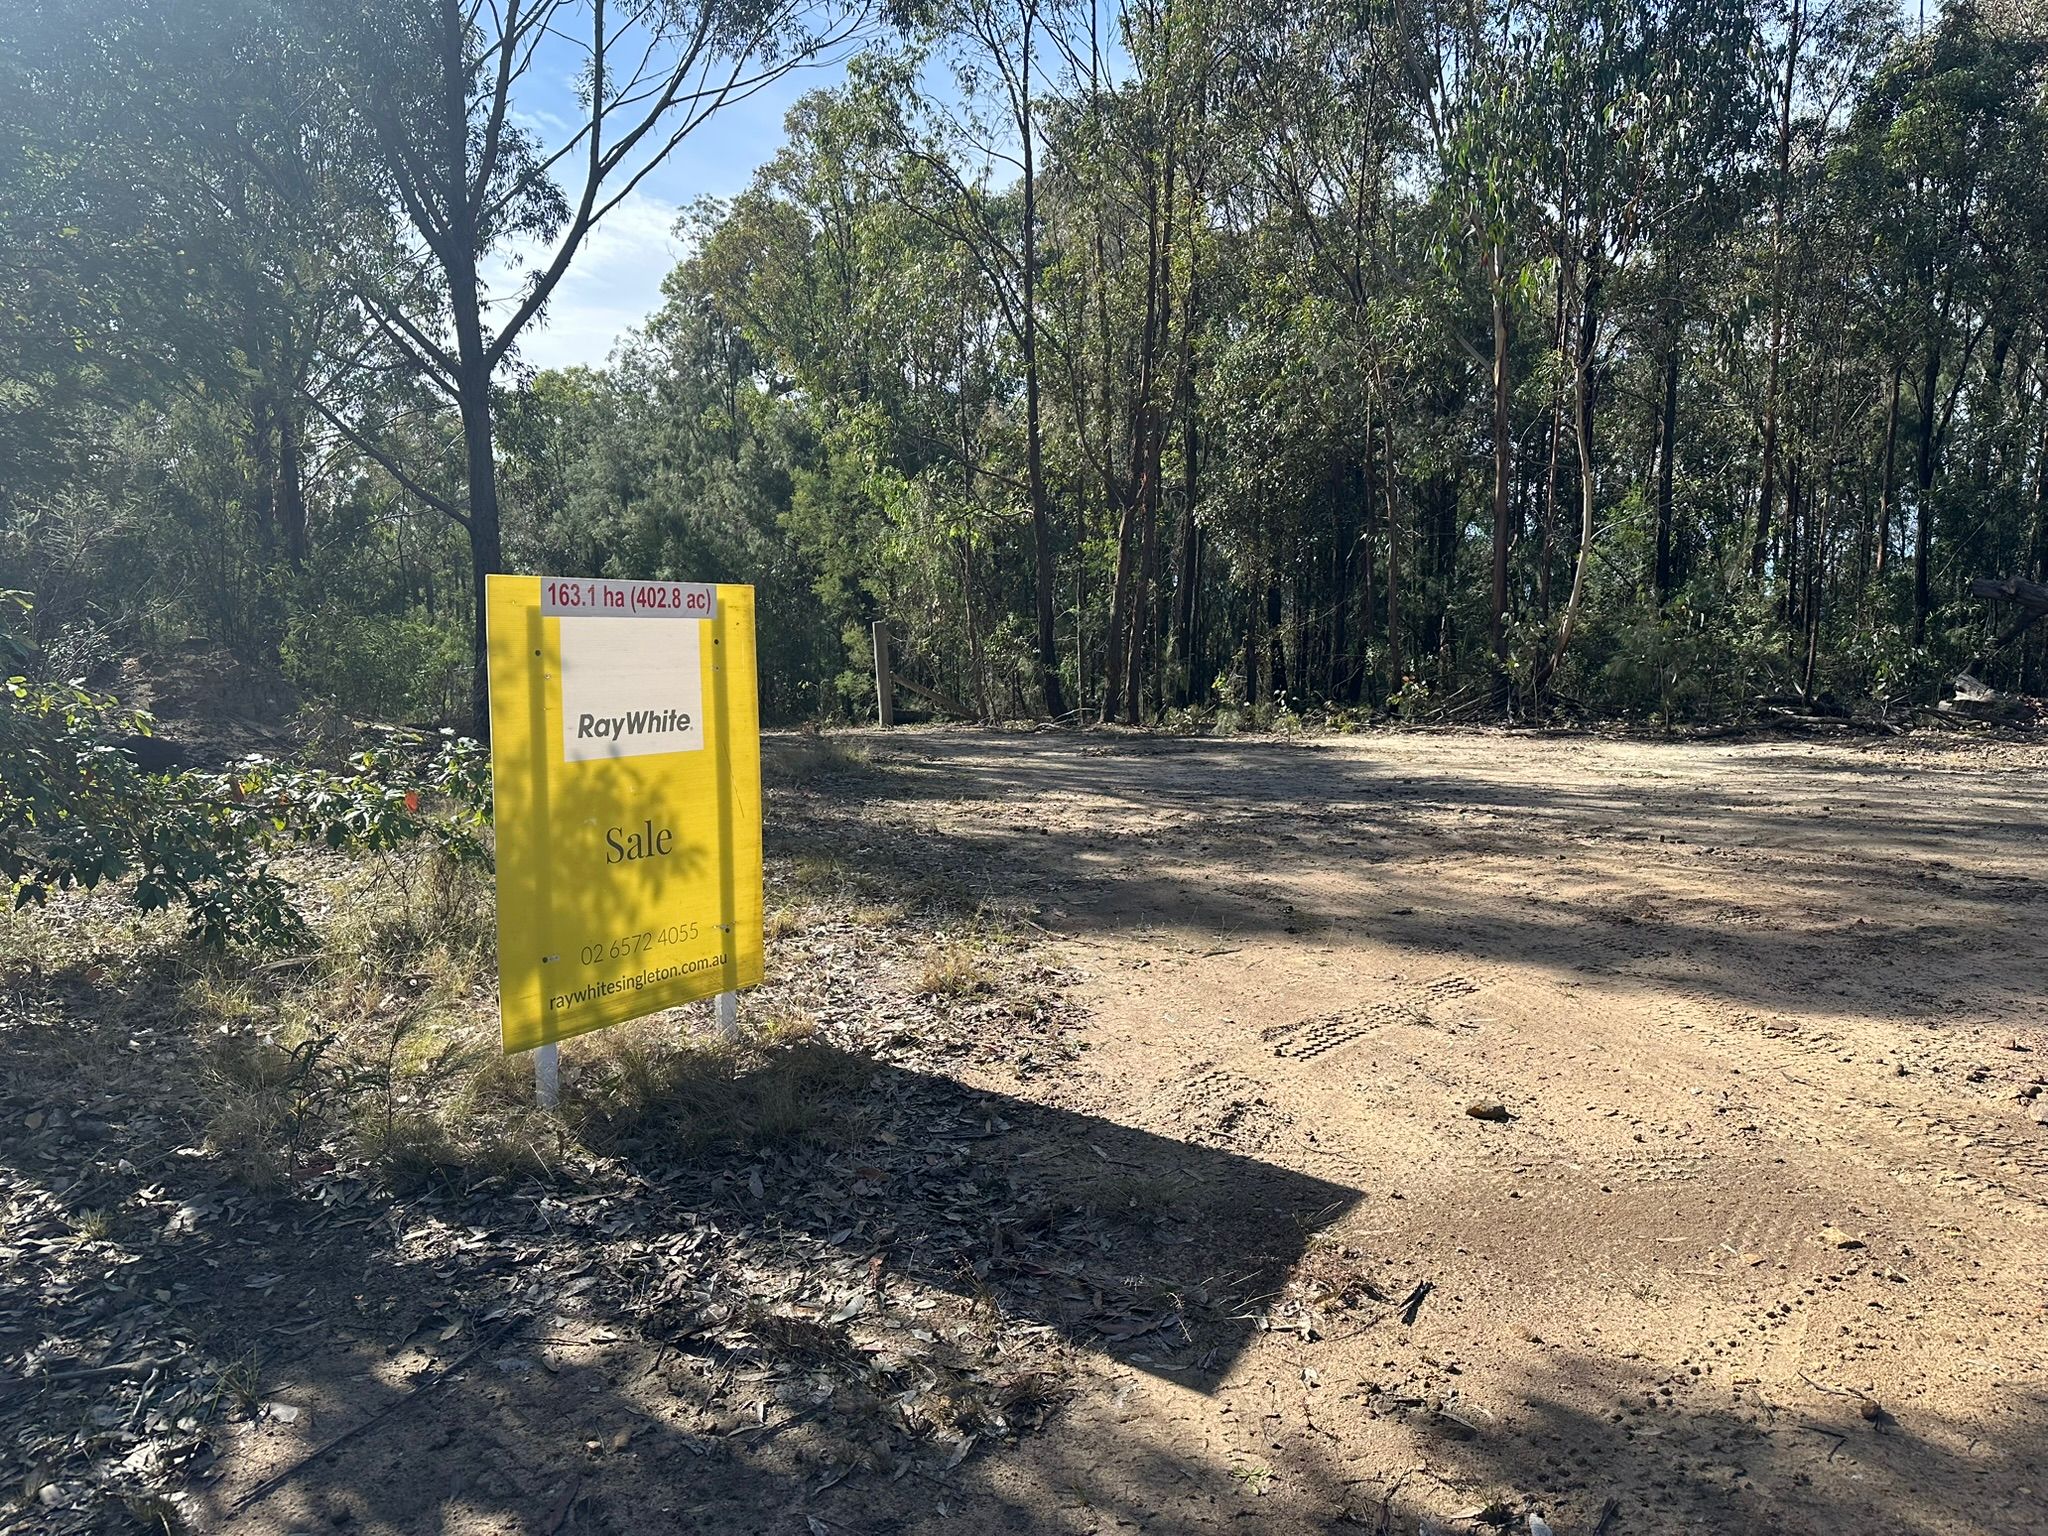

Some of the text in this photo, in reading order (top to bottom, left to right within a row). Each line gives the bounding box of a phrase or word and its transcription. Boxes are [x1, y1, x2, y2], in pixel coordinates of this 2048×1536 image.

[548, 583, 711, 614] 163.1 ha (402.8 ac)
[606, 820, 673, 864] Sale
[580, 921, 699, 966] 02 6572 4055
[550, 952, 728, 1010] raywhitesingleton.com.au
